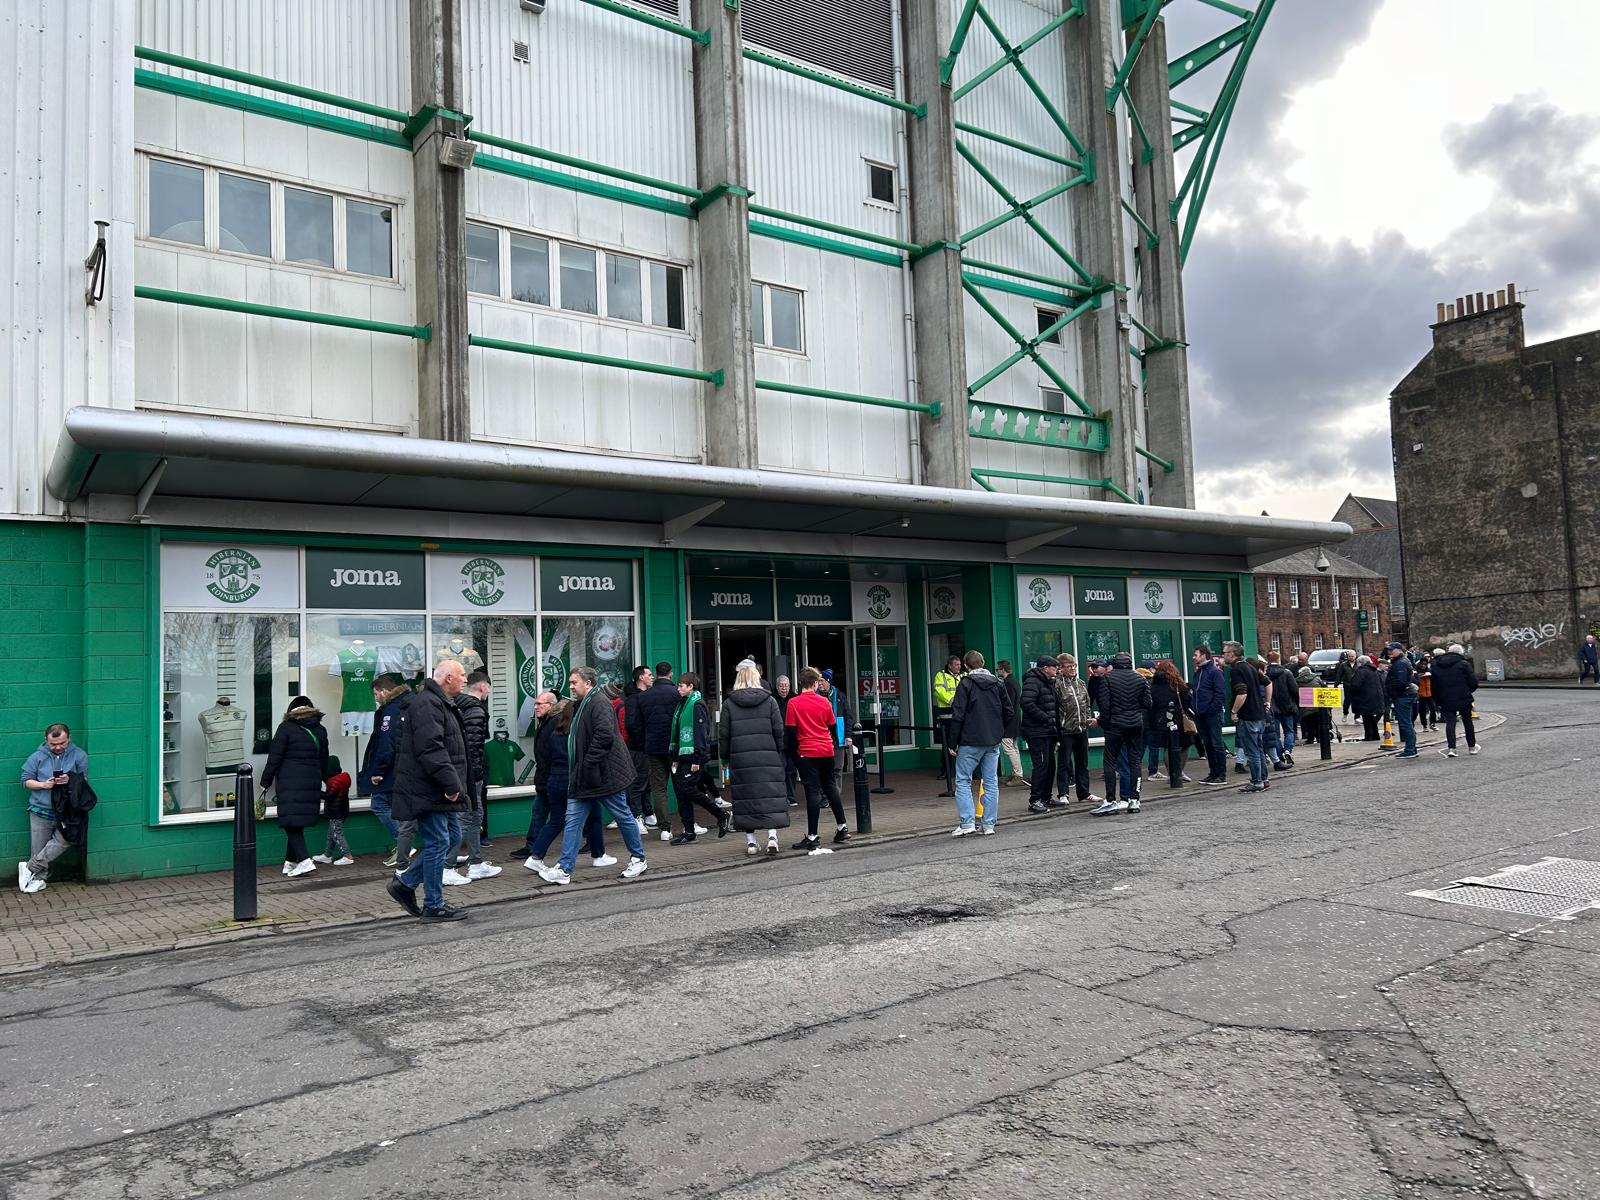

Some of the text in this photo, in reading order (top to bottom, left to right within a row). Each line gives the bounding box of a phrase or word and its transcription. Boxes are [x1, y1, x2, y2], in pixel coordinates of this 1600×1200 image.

[209, 550, 258, 567] HIBERNIAN
[210, 586, 256, 602] EDINBURGH
[863, 679, 896, 694] SLE
